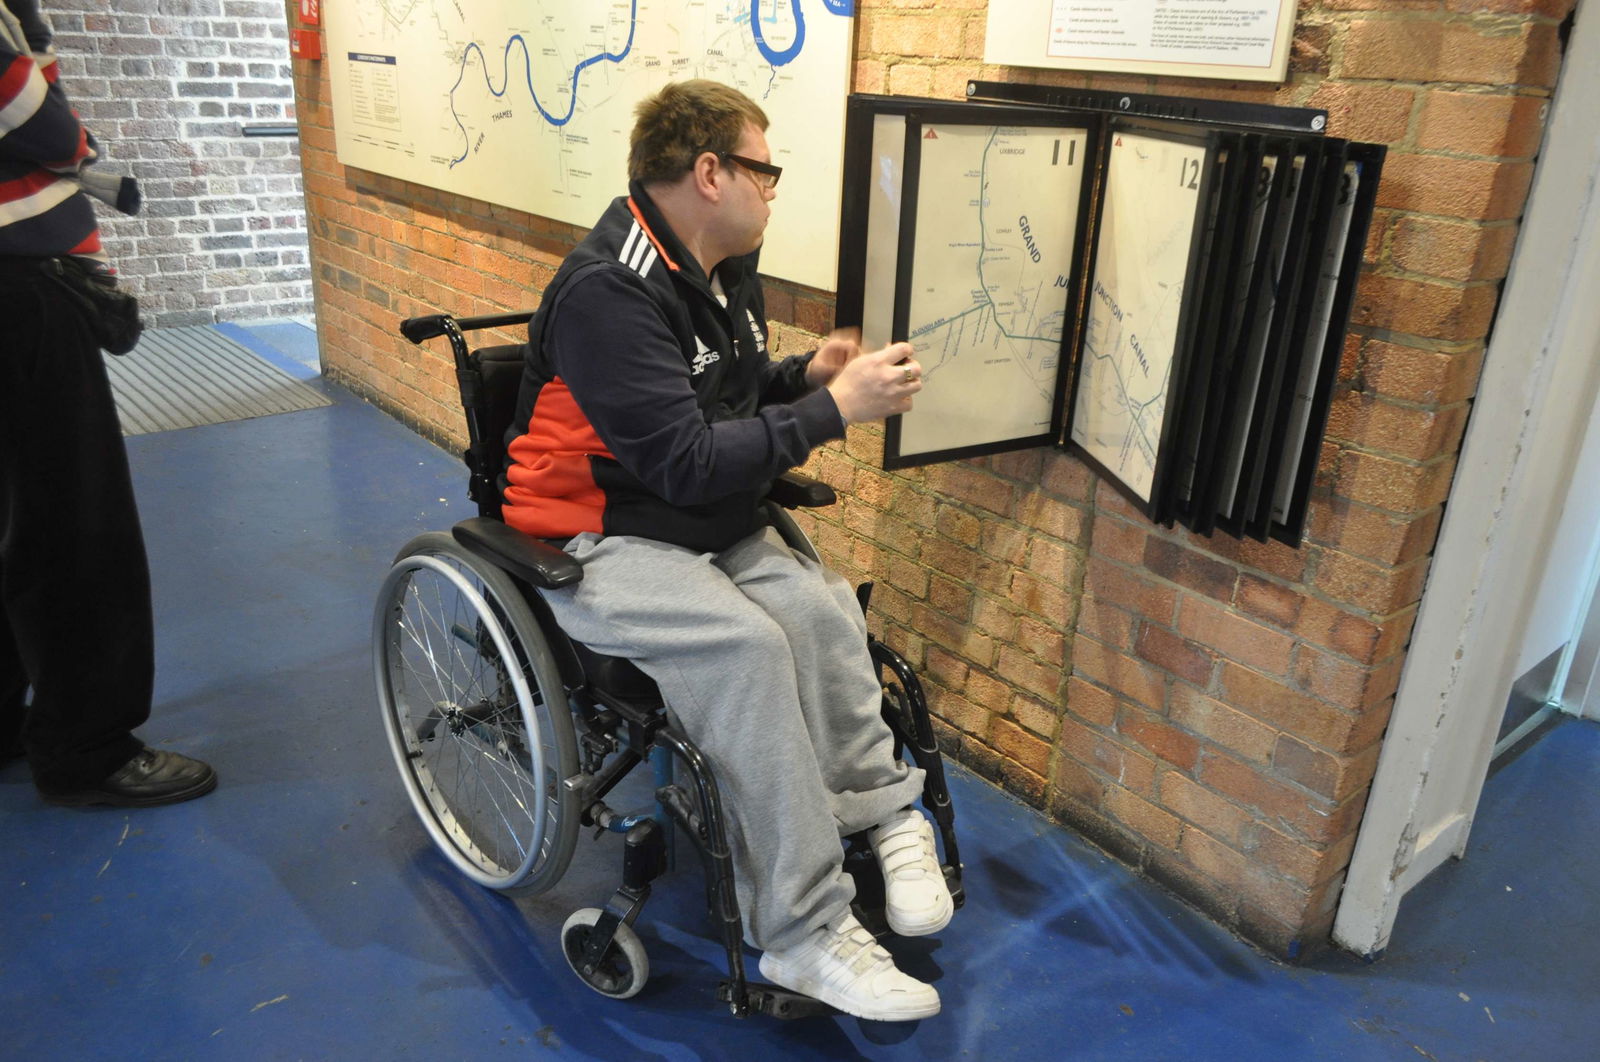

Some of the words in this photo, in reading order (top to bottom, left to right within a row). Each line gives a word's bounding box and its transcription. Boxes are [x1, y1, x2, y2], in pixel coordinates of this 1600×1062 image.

[492, 110, 513, 122] THAMES
[1051, 139, 1076, 166] 11
[1180, 157, 1200, 190] 12
[1019, 215, 1041, 263] GRAND
[1094, 281, 1124, 322] JUNCTION
[1130, 334, 1150, 378] CANAL
